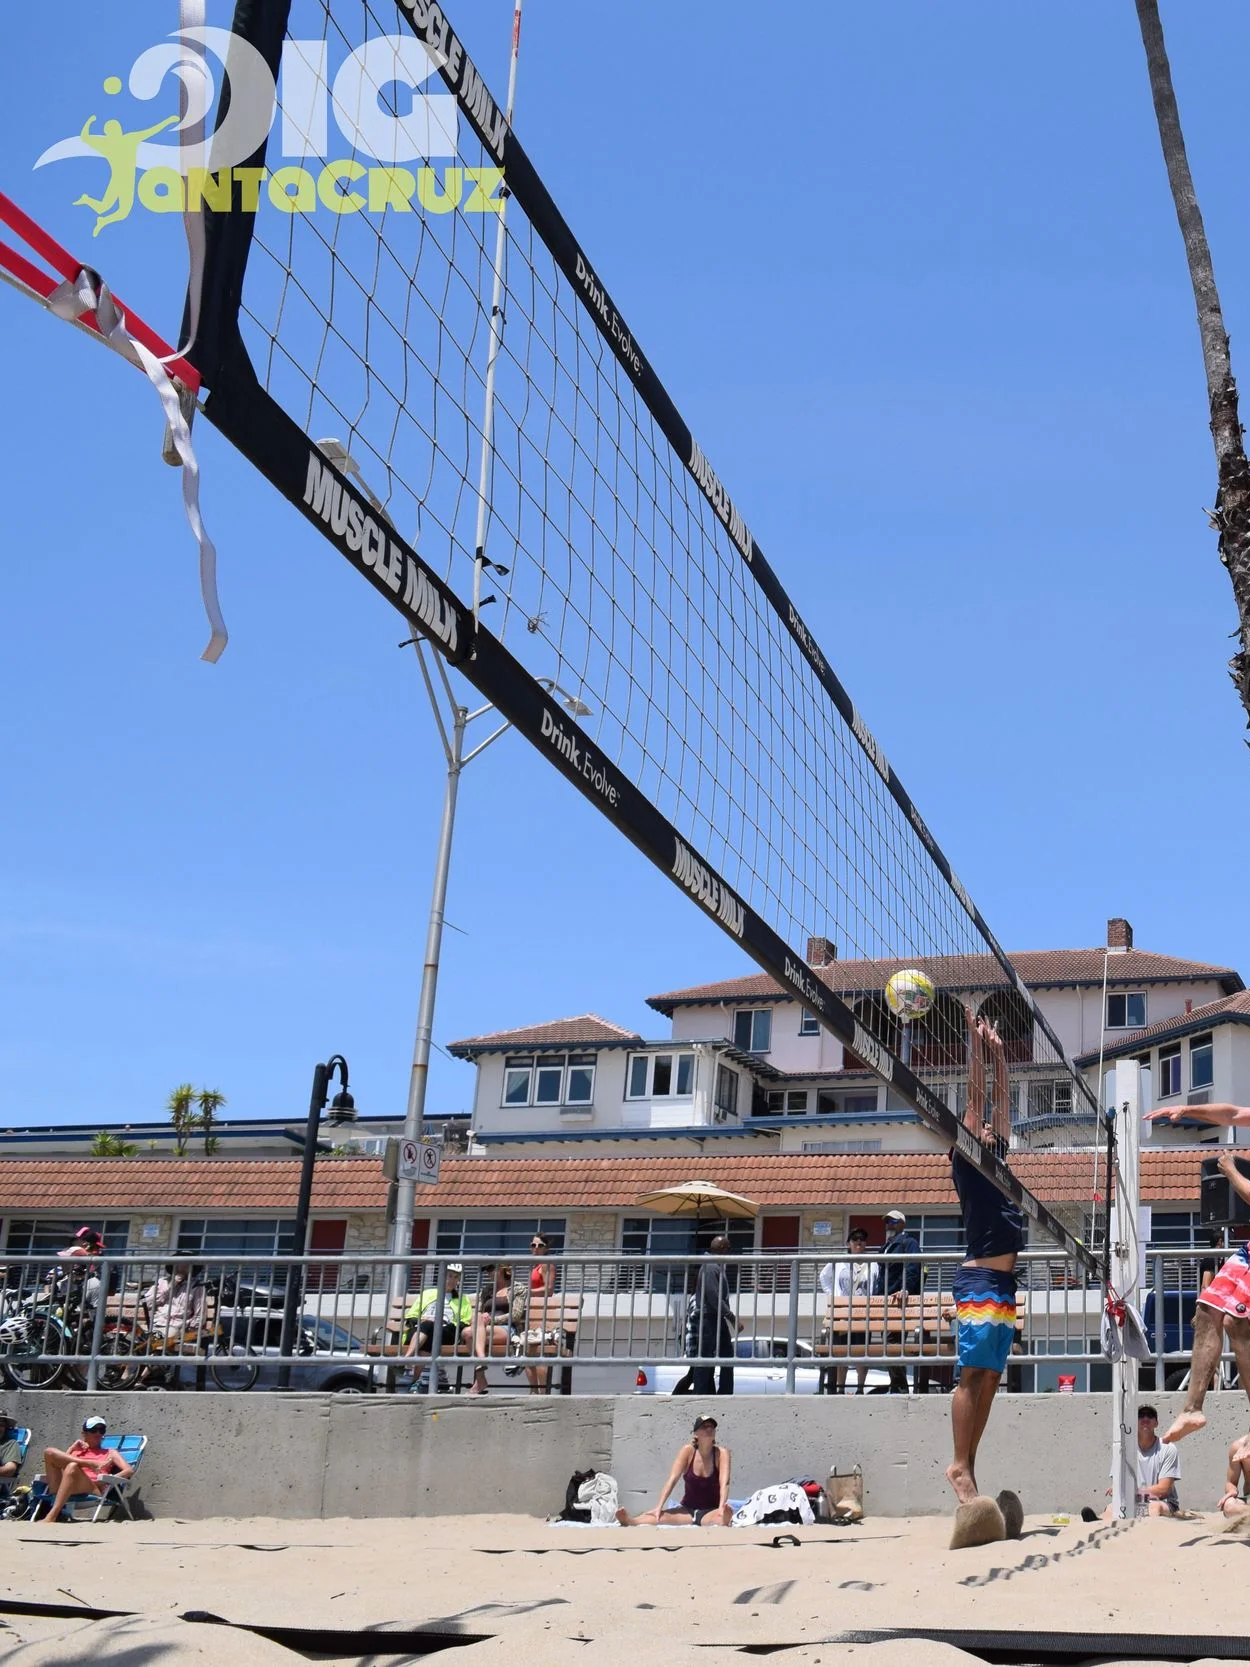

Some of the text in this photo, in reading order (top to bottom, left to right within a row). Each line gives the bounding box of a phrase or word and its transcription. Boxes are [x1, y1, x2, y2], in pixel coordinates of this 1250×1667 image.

[459, 55, 509, 161] MILK
[303, 450, 458, 652] MUSCLE MILK
[689, 434, 753, 563] MUSCLE MILK
[540, 707, 581, 770] Drink.
[671, 836, 746, 938] MUSCLE MILK
